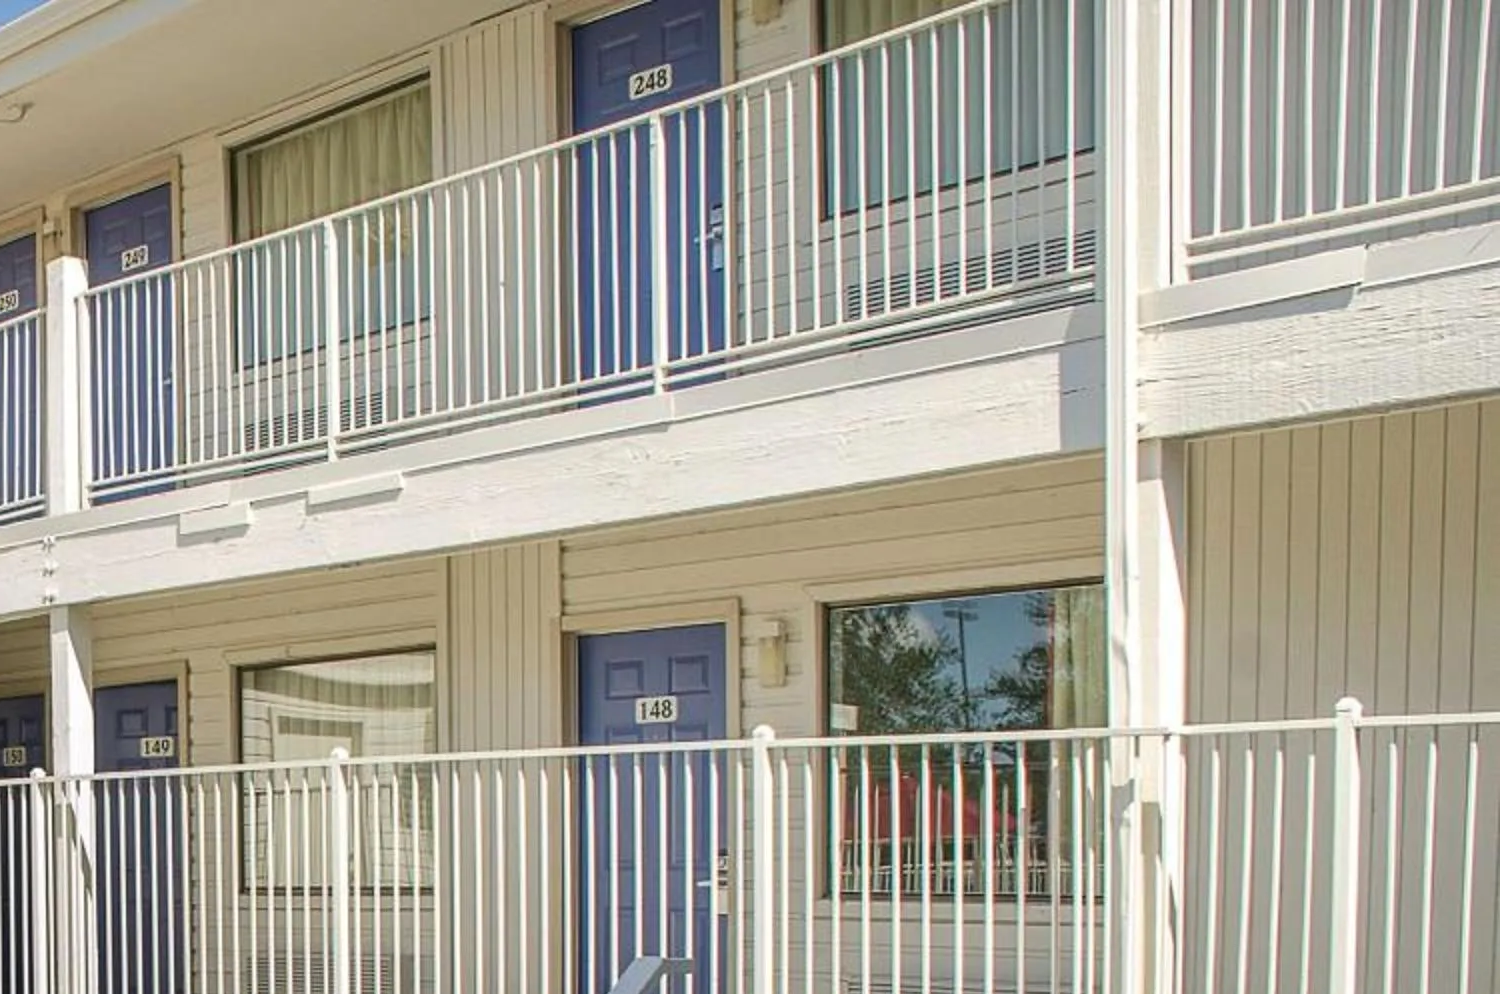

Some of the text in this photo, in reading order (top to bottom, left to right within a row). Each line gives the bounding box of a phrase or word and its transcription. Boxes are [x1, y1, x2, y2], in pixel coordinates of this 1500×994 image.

[633, 69, 668, 96] 248
[124, 247, 147, 268] 249
[0, 292, 17, 311] 250
[642, 699, 673, 720] 148
[145, 739, 171, 755] 149
